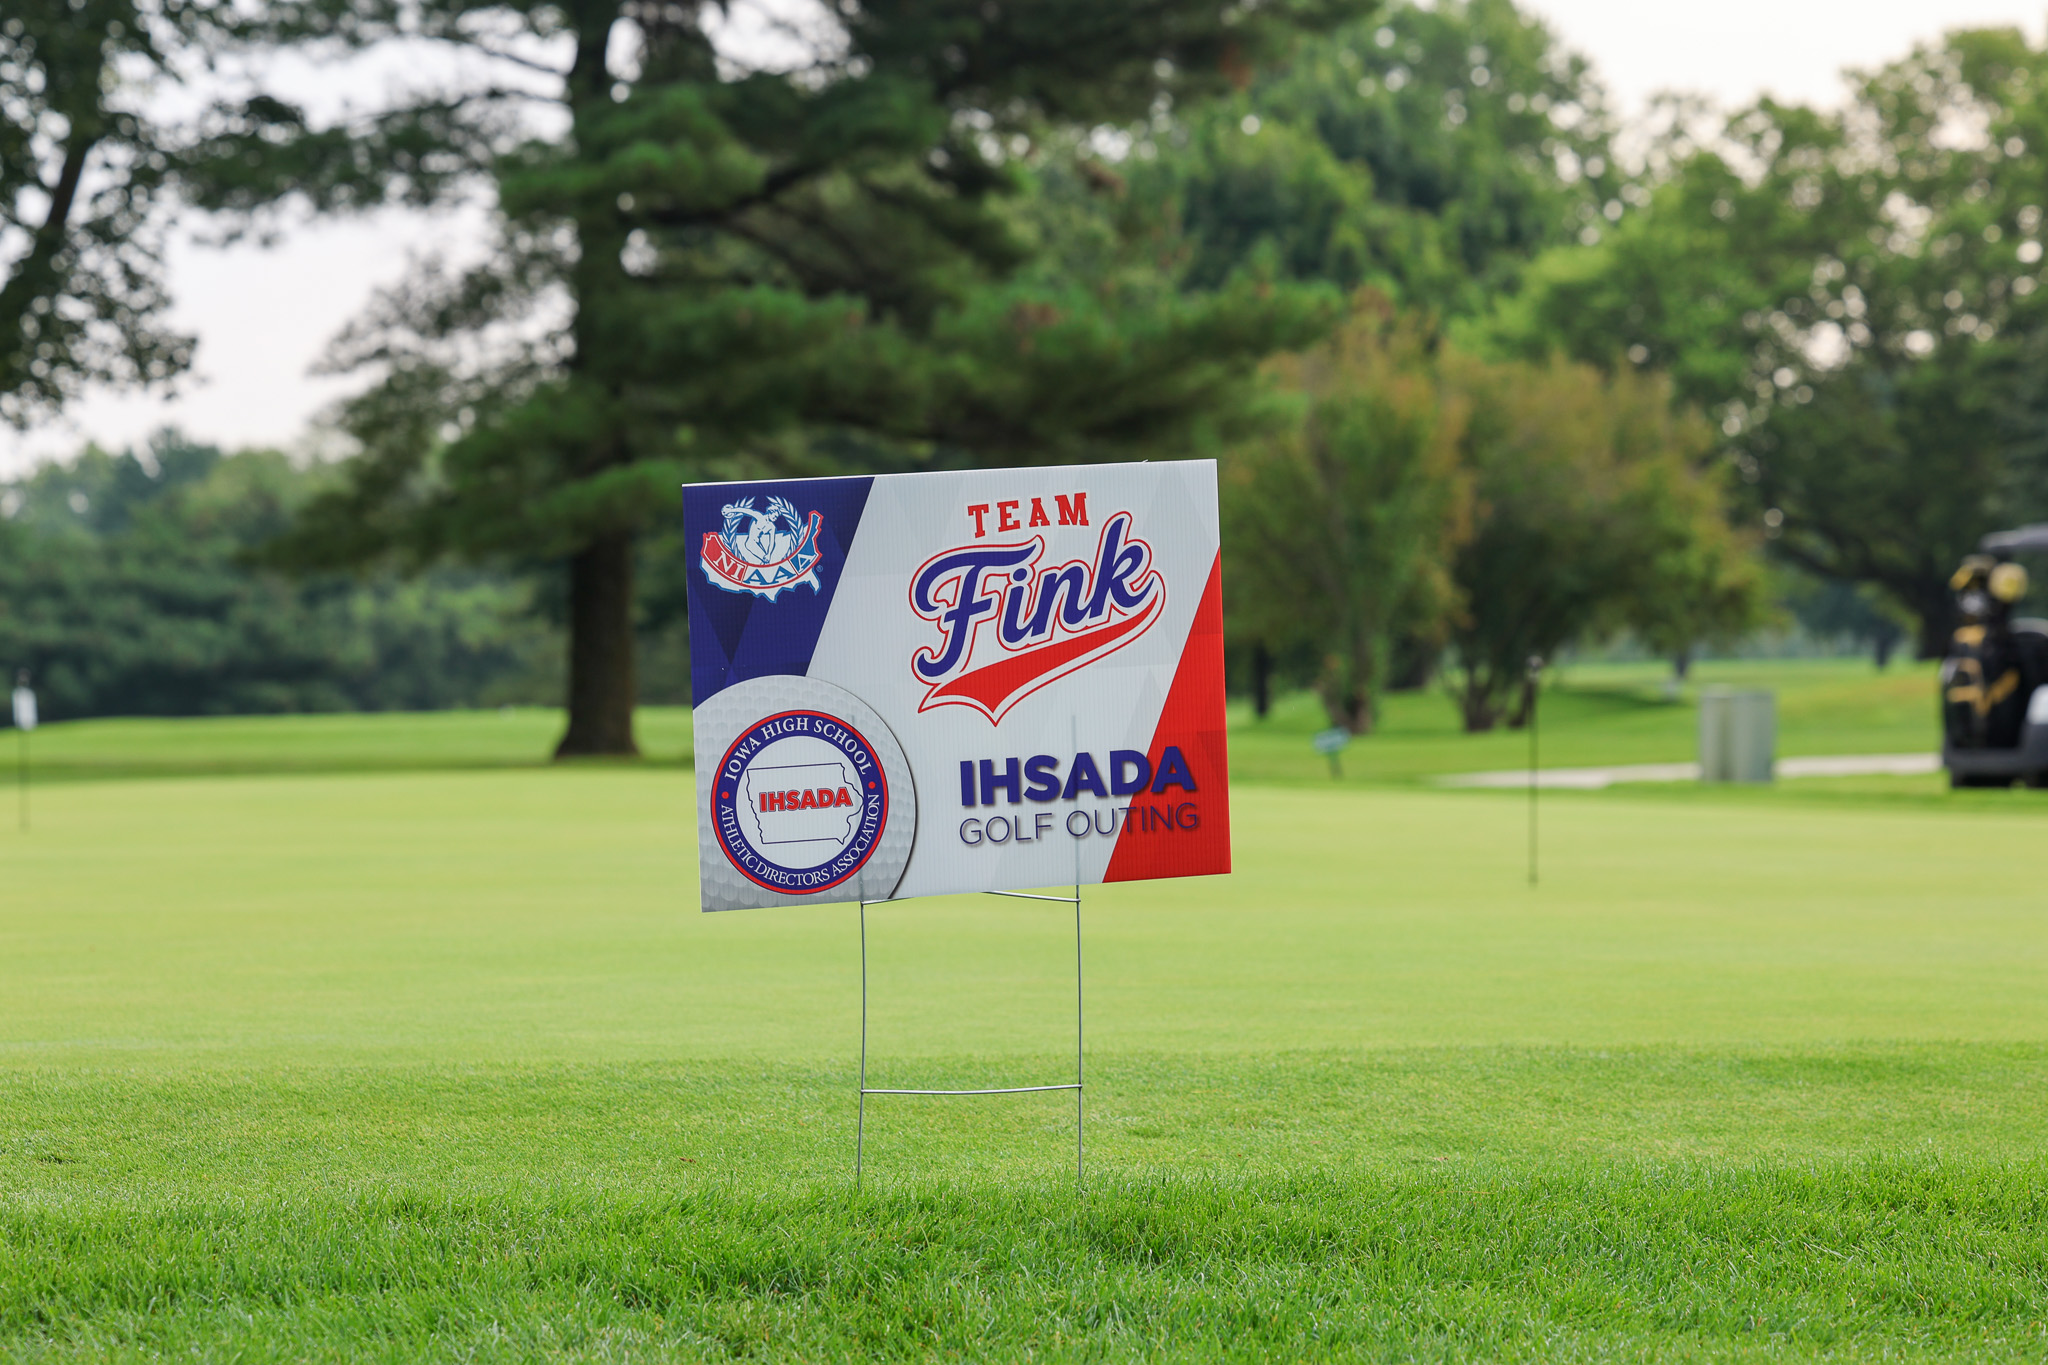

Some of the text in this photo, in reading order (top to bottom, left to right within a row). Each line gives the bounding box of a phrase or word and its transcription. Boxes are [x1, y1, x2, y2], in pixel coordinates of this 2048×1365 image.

[968, 492, 1089, 538] TEAM
[712, 550, 818, 586] NIAAA
[912, 515, 1157, 679] Fink
[725, 717, 872, 781] IOWA HIGH SCHOOL
[759, 787, 853, 813] IHSADA
[960, 746, 1197, 806] IHSADA
[721, 794, 880, 886] ATHLETIC DIRECTORS ASSOCIATION
[959, 802, 1198, 845] GOLF OUTING
